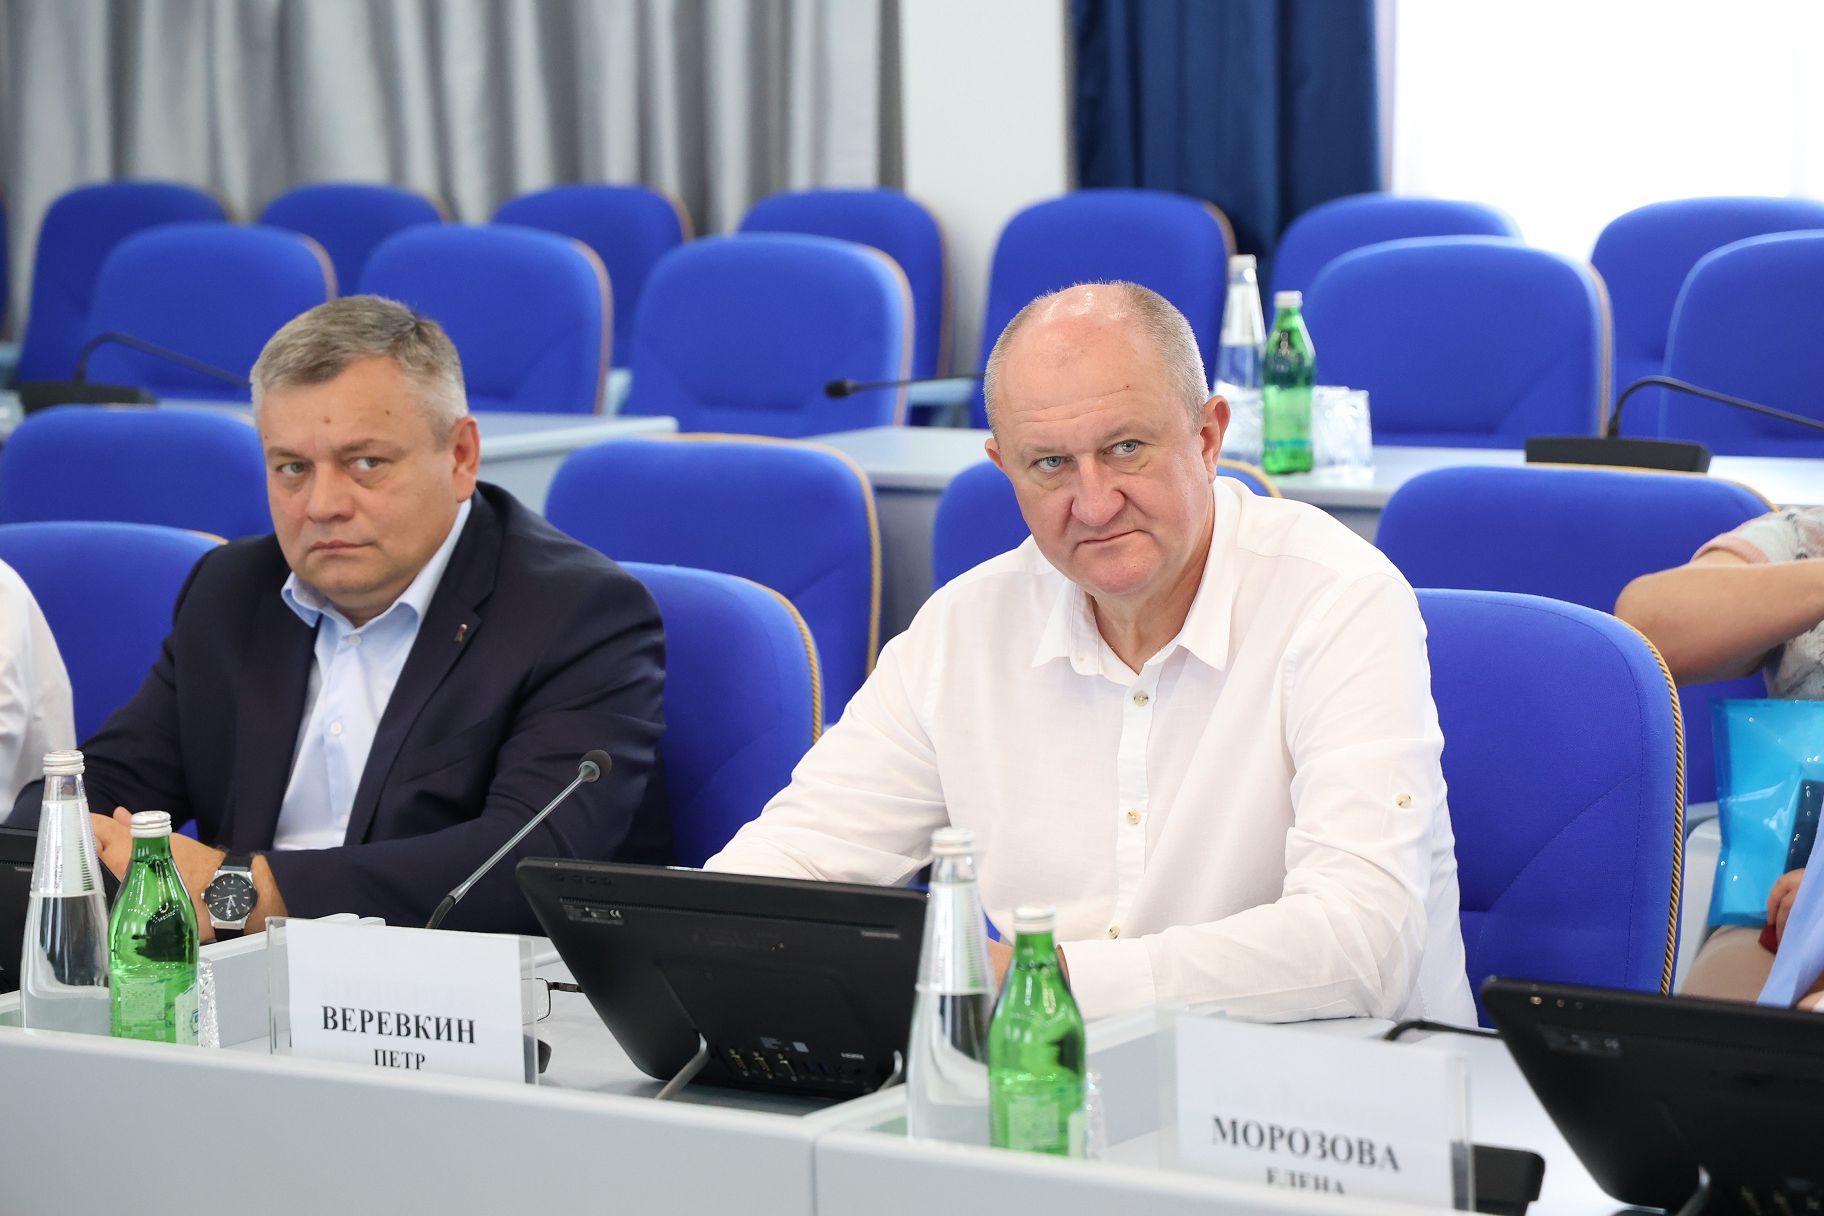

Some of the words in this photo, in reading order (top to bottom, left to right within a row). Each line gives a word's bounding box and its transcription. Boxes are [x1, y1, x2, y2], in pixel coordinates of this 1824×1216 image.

[322, 1006, 475, 1044] ВЕРЕВКИН
[374, 1049, 426, 1070] ПЕТР
[1213, 1116, 1400, 1171] МОРОЗОВА
